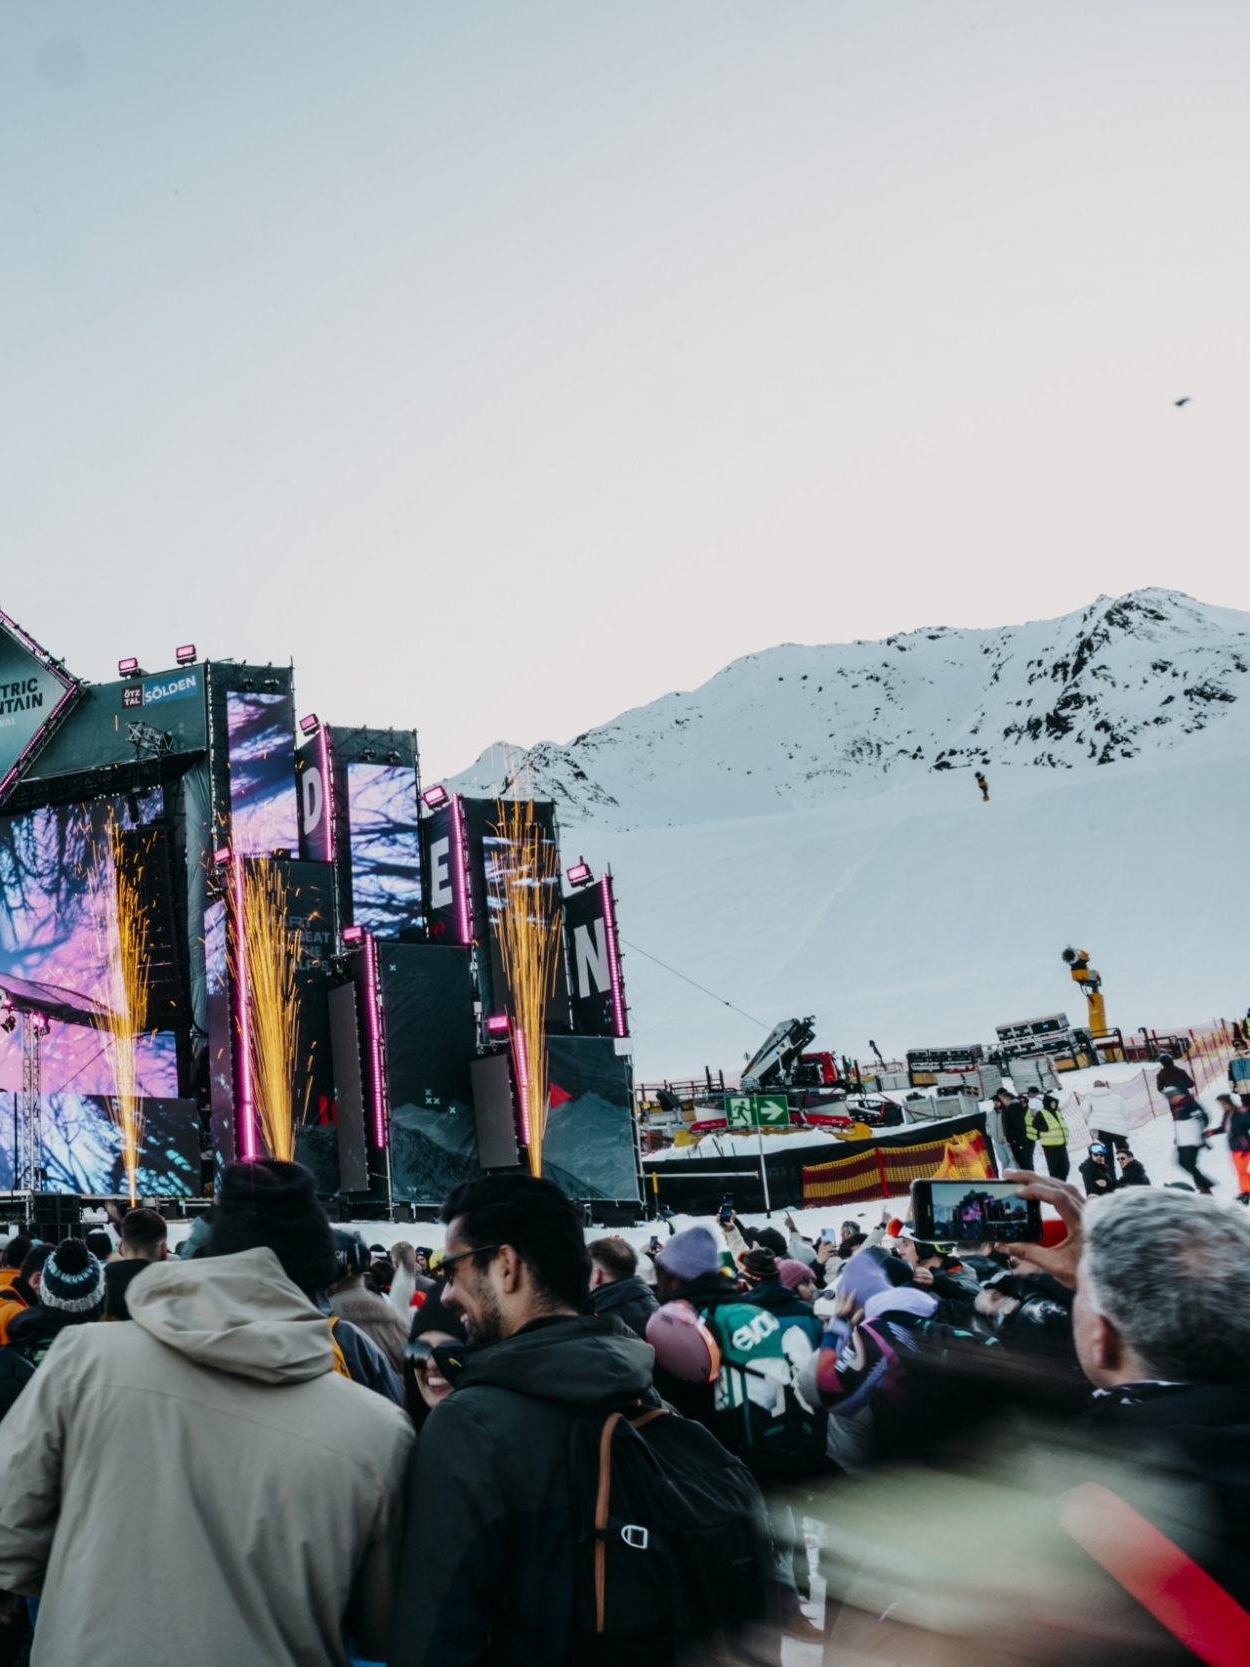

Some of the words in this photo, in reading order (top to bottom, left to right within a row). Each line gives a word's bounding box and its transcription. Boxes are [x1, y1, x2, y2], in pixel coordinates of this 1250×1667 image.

[124, 689, 140, 698] ÖTZ
[124, 698, 140, 706] TAL
[145, 676, 196, 702] SÖLDEN
[302, 766, 323, 836] D
[431, 836, 453, 910] E
[573, 916, 612, 999] N
